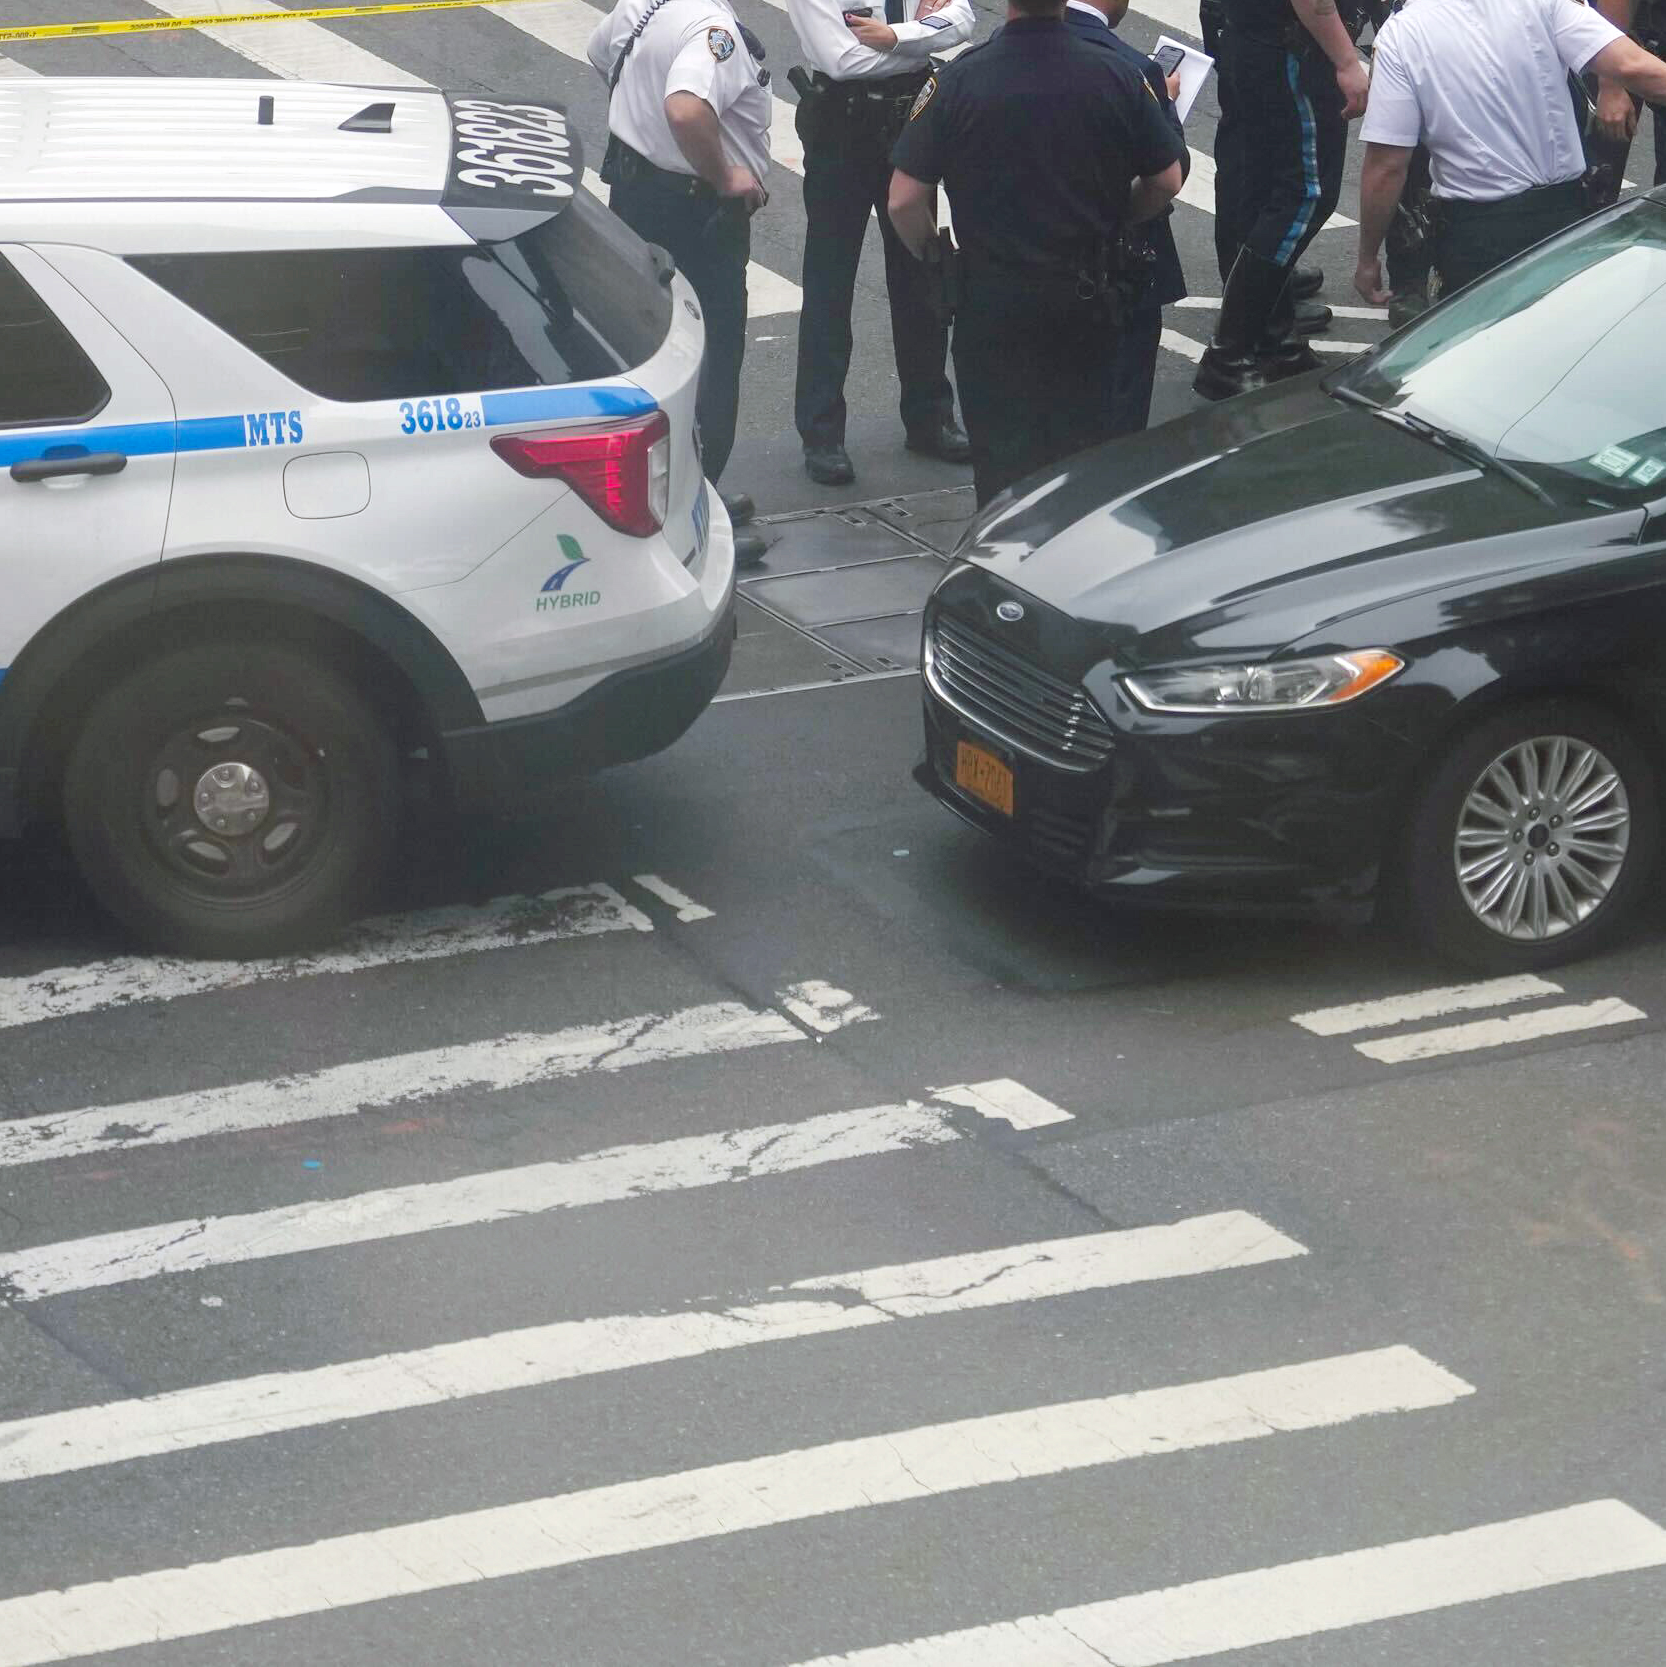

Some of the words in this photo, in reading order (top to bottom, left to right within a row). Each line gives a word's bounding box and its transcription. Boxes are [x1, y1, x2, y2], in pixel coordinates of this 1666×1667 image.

[453, 99, 574, 197] 361823
[246, 410, 303, 447] MTS
[535, 590, 601, 612] HYBRID
